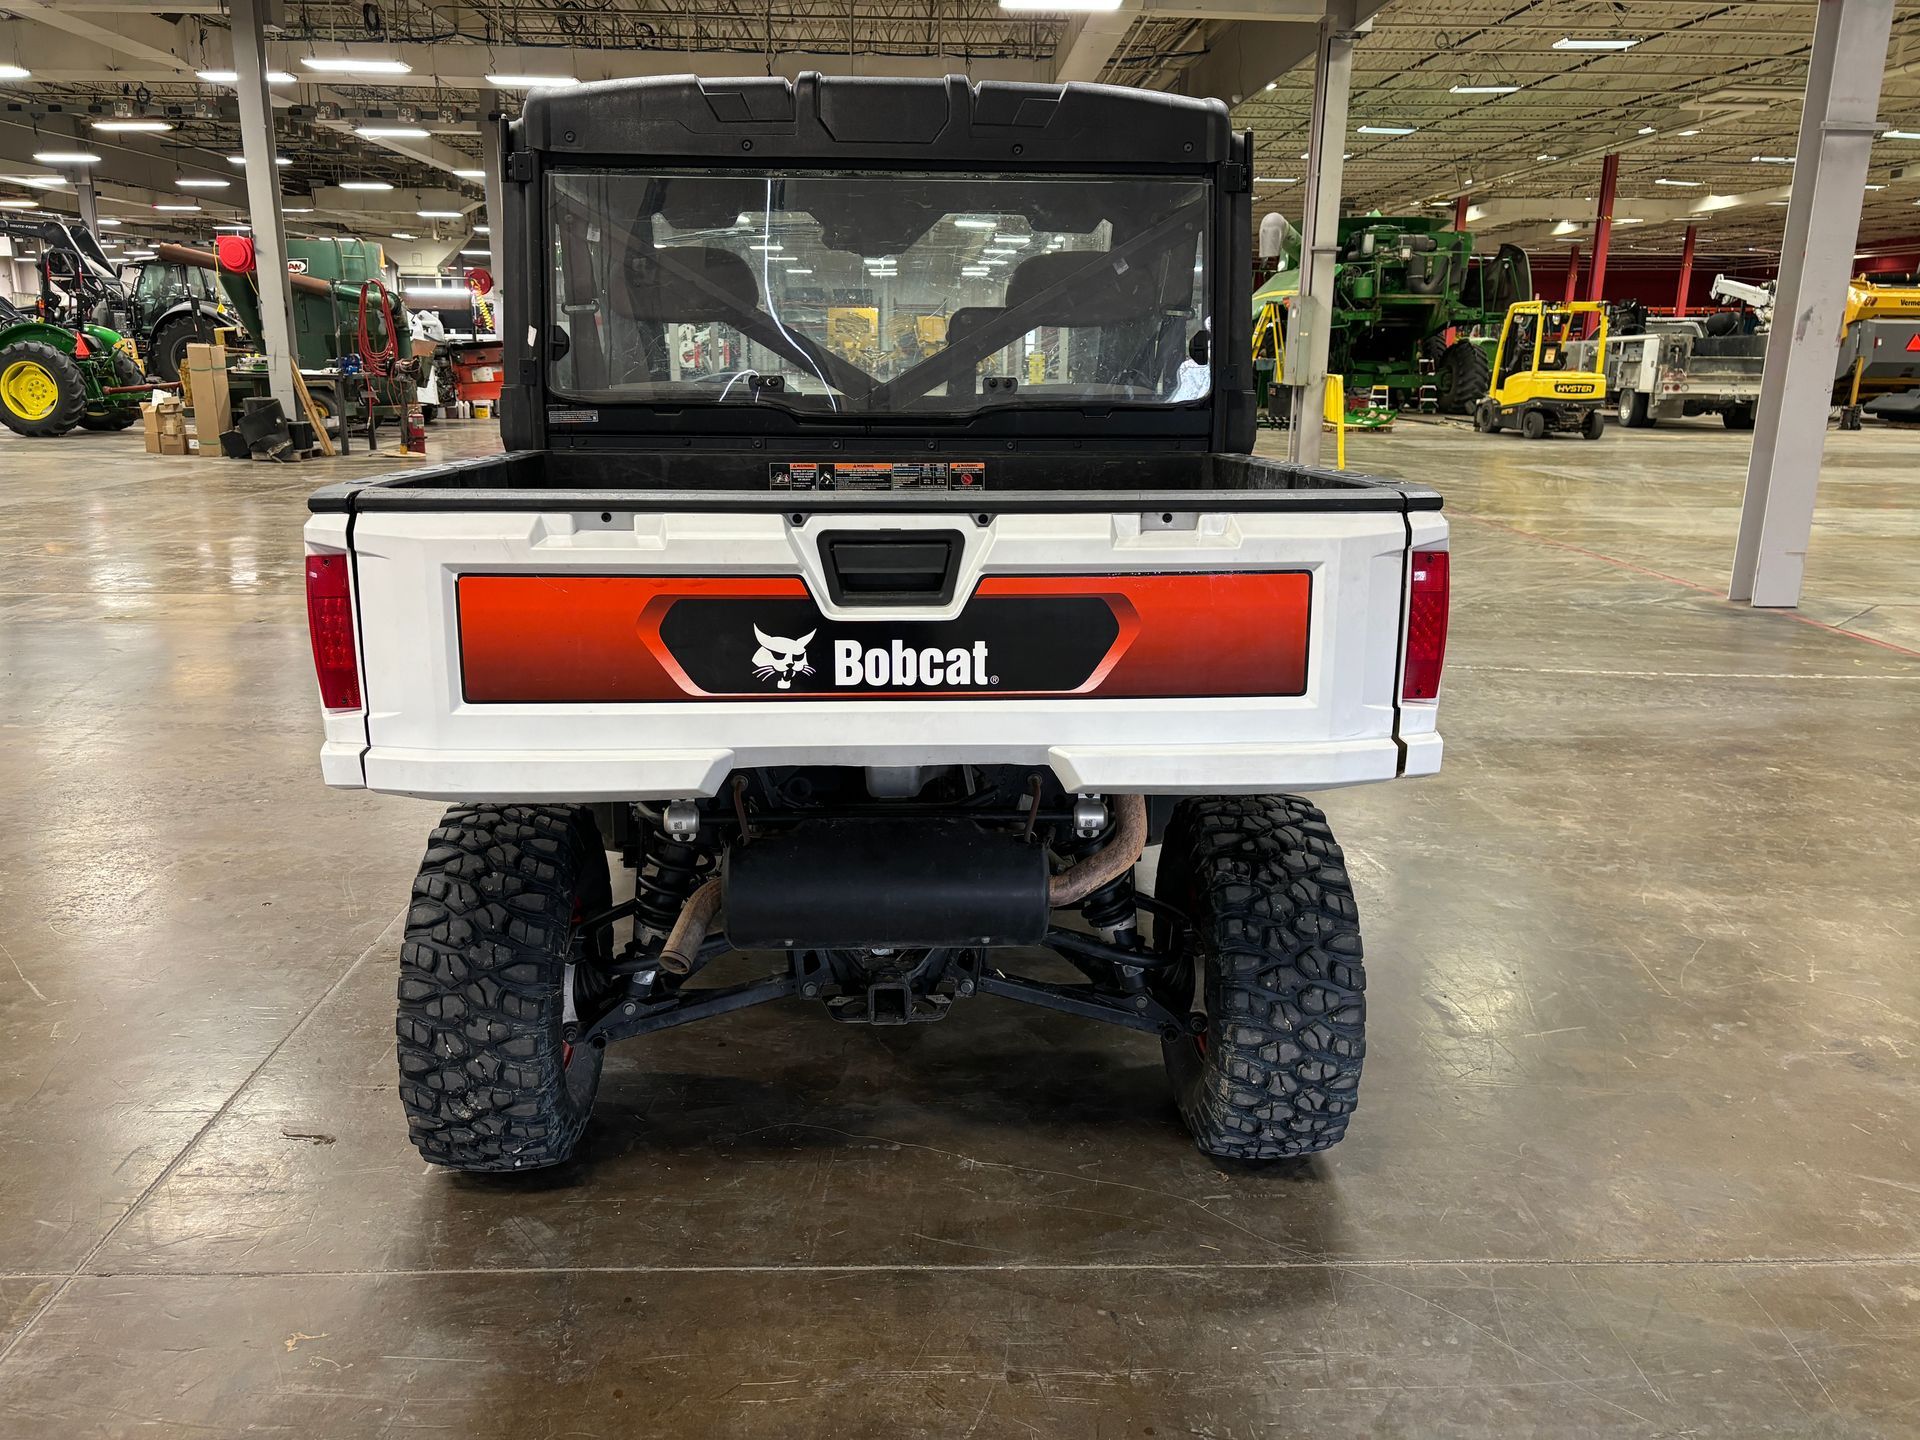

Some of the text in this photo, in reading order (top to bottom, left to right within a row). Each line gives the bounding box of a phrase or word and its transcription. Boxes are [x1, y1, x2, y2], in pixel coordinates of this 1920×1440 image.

[401, 108, 411, 117] 93
[442, 110, 453, 119] 95
[1557, 385, 1593, 393] HYSTER
[834, 639, 988, 686] Bobcat
